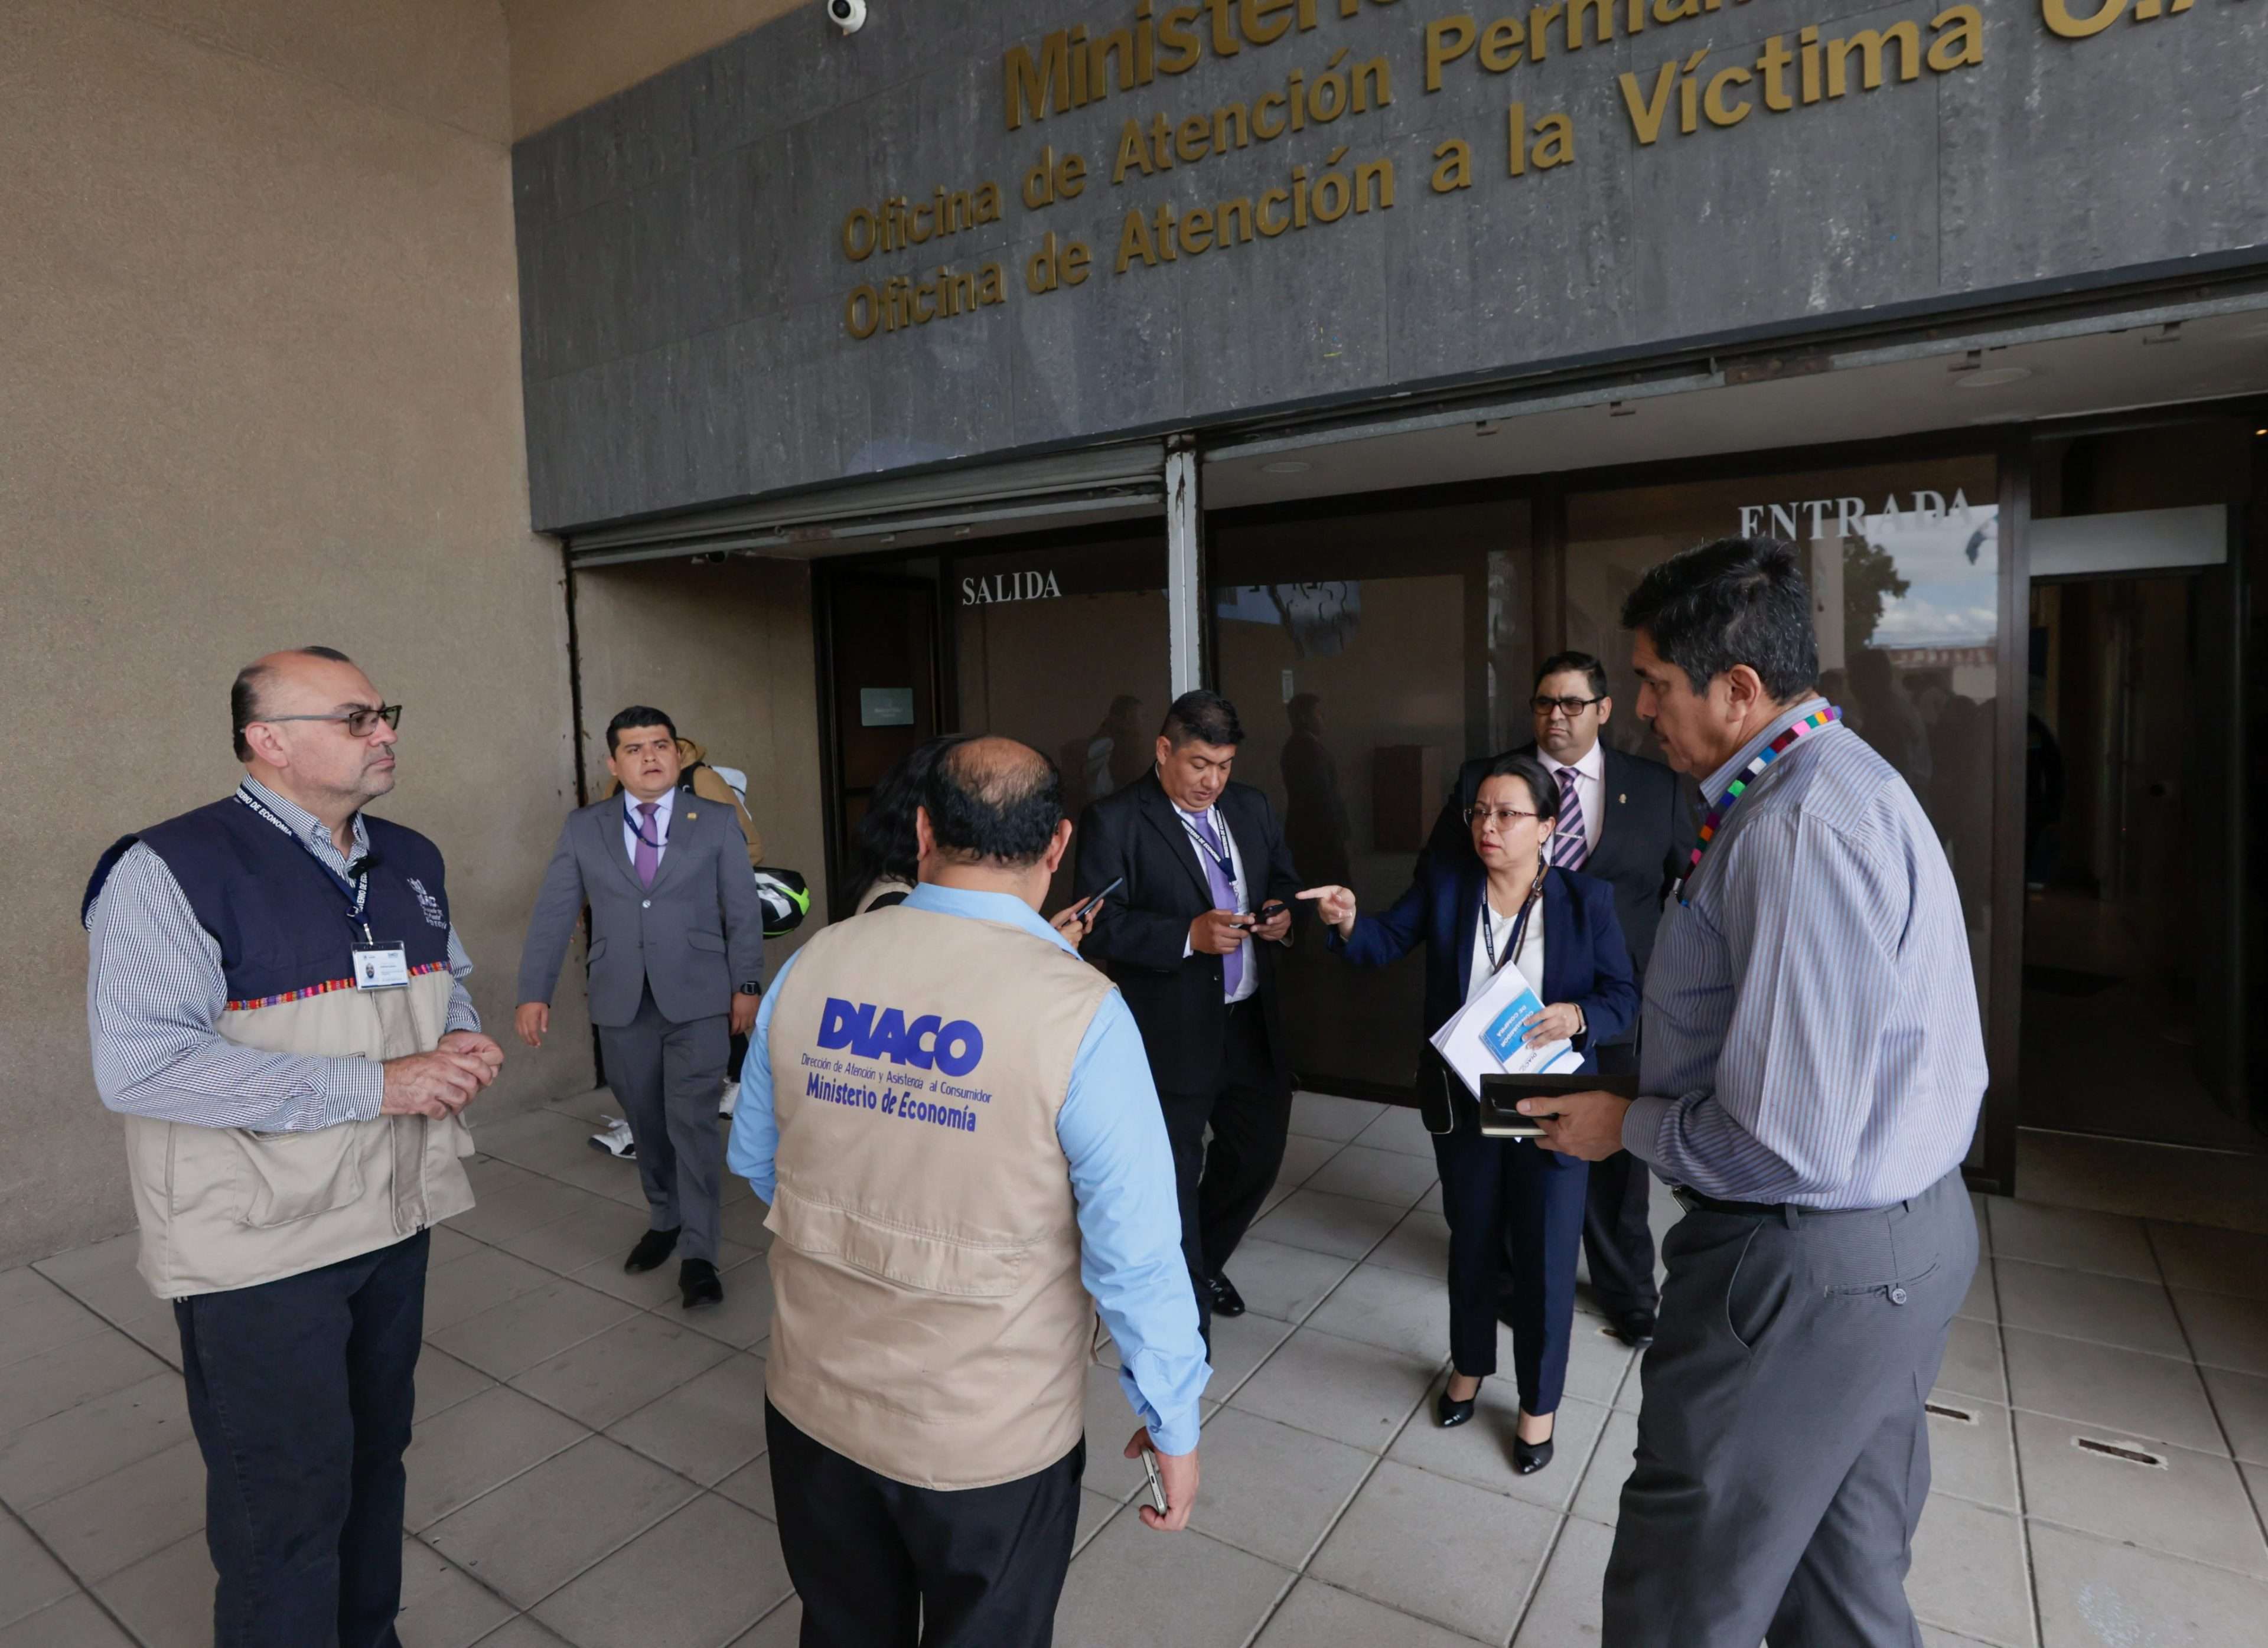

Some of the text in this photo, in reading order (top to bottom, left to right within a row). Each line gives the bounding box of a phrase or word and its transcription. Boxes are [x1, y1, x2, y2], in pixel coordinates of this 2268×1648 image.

[1004, 0, 1400, 131] Ministe
[841, 180, 1001, 262] Oficina
[1022, 145, 1087, 210] de
[1112, 48, 1391, 185] Atención
[843, 260, 1006, 340] Oficina
[1025, 231, 1091, 294] de
[1115, 146, 1394, 273] Atención
[1430, 138, 1472, 194] a
[1508, 103, 1575, 176] la
[1619, 3, 1985, 145] Víctima
[1738, 487, 1973, 541] ENTRADA
[962, 570, 1061, 605] SALIDA
[249, 801, 262, 811] DE
[258, 808, 292, 836] ECONOMIA
[817, 997, 983, 1076] DIACO
[801, 1053, 993, 1103] Dirección de Atención y Asistencia al Consumidor
[806, 1072, 976, 1132] Ministerio de Economía
